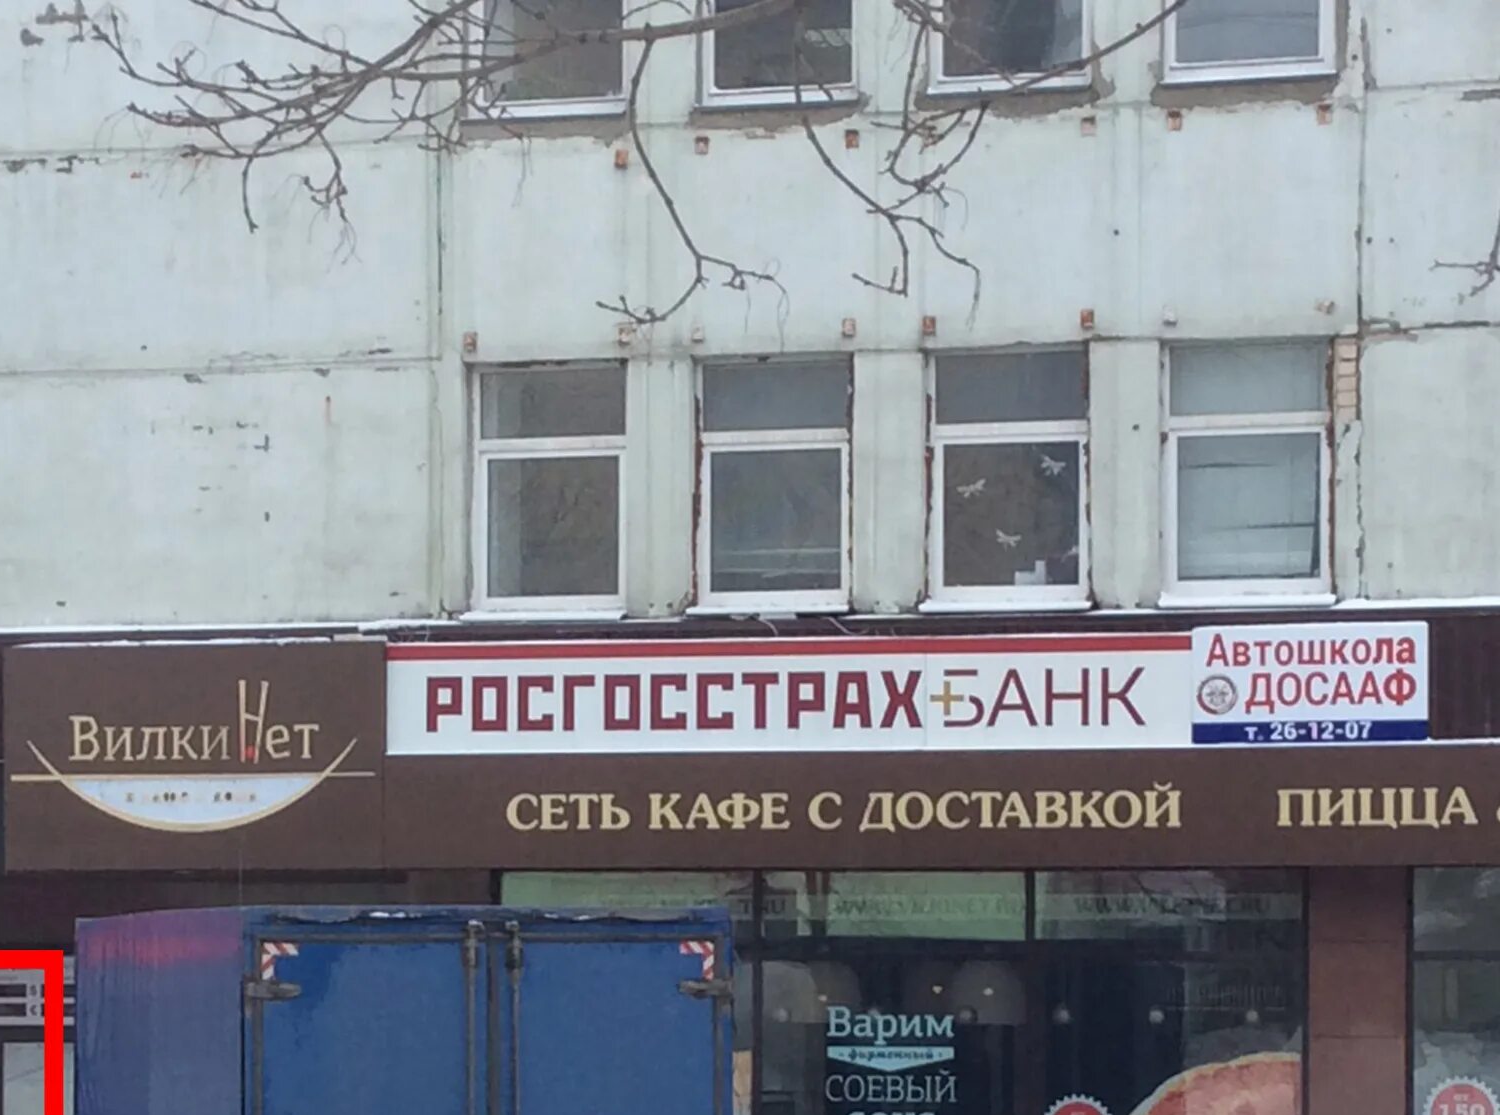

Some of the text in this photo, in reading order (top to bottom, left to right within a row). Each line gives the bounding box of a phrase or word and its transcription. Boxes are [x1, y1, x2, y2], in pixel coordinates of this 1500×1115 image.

[1206, 634, 1417, 667] Автошкола
[426, 671, 923, 733] РОСГОССТРАХ
[1245, 668, 1418, 714] ДОСААФ
[1270, 721, 1372, 740] 26-12-07
[506, 782, 1182, 832] СЕТЬ КАФЕ С ДОСТАВКОЙ
[1277, 787, 1478, 829] ПИЦЦА
[826, 1006, 955, 1045] Варим
[825, 1069, 957, 1102] СОЕВЫЙ
